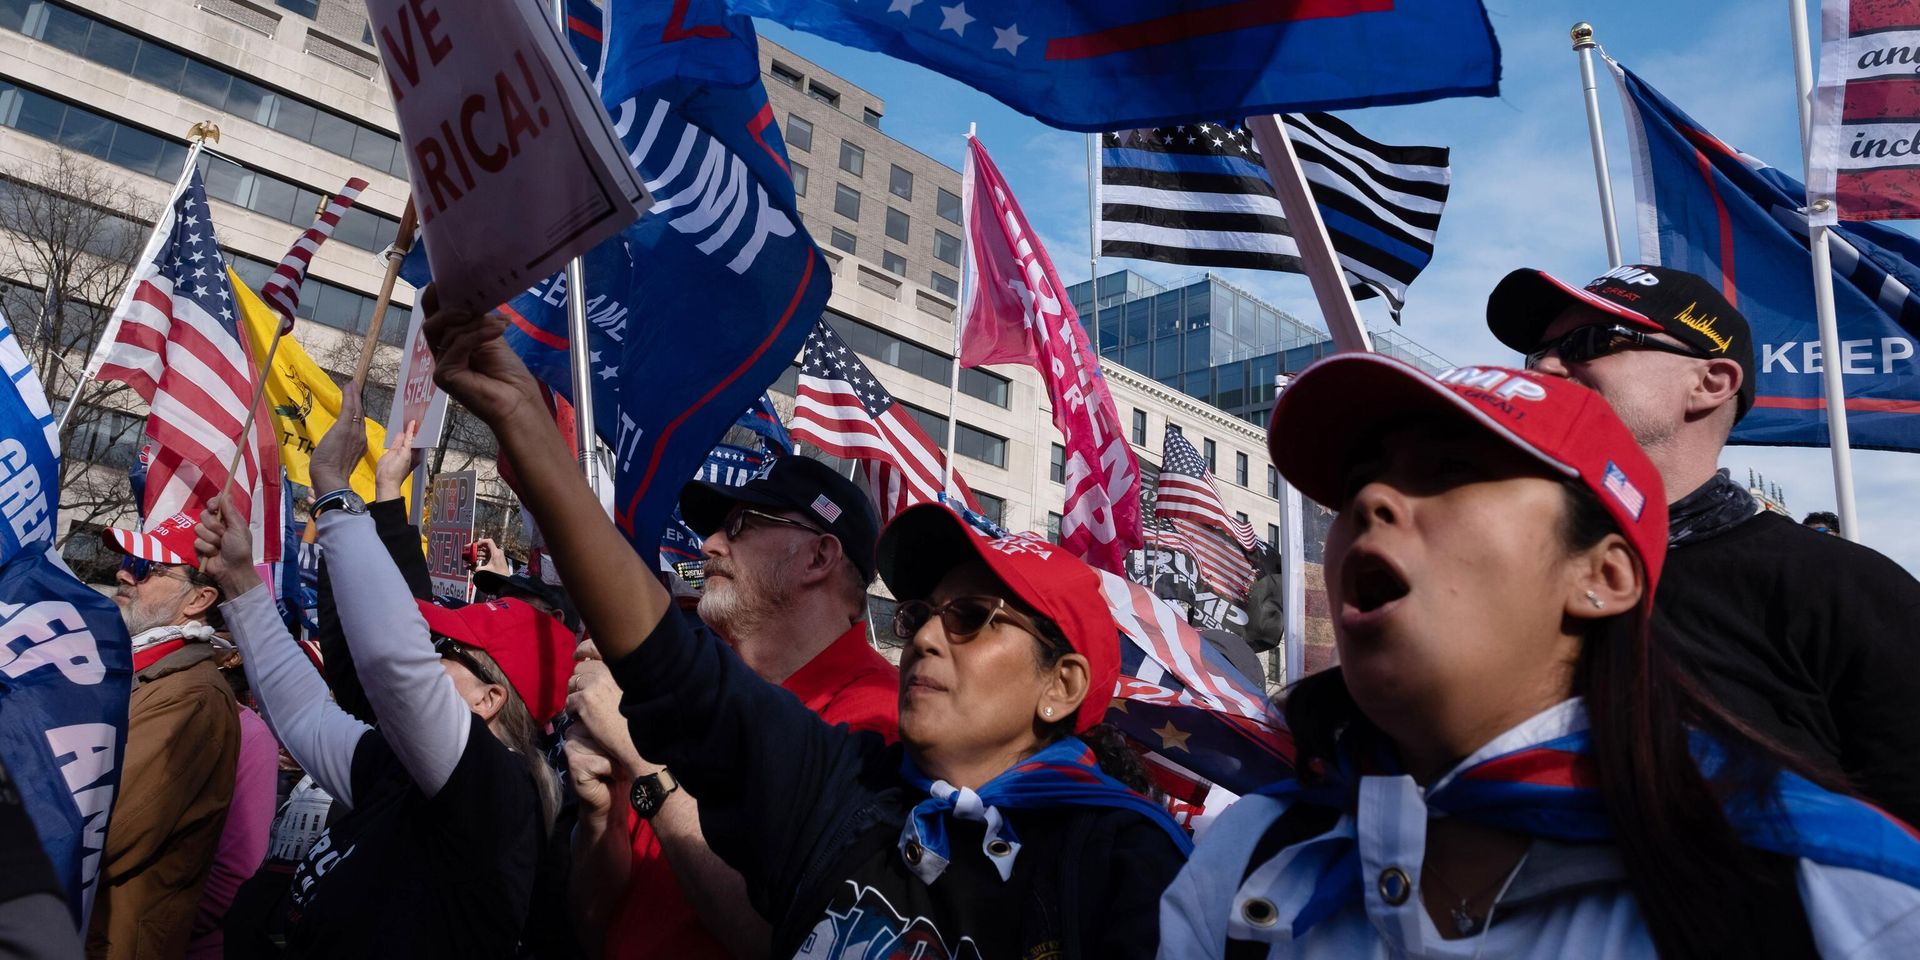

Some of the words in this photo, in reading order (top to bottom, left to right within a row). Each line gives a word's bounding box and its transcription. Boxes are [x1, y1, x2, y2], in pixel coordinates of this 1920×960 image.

[380, 0, 453, 102] VE
[416, 49, 549, 224] RICA!
[1761, 337, 1914, 375] KEEP
[431, 476, 470, 524] STOP
[0, 600, 107, 686] EP
